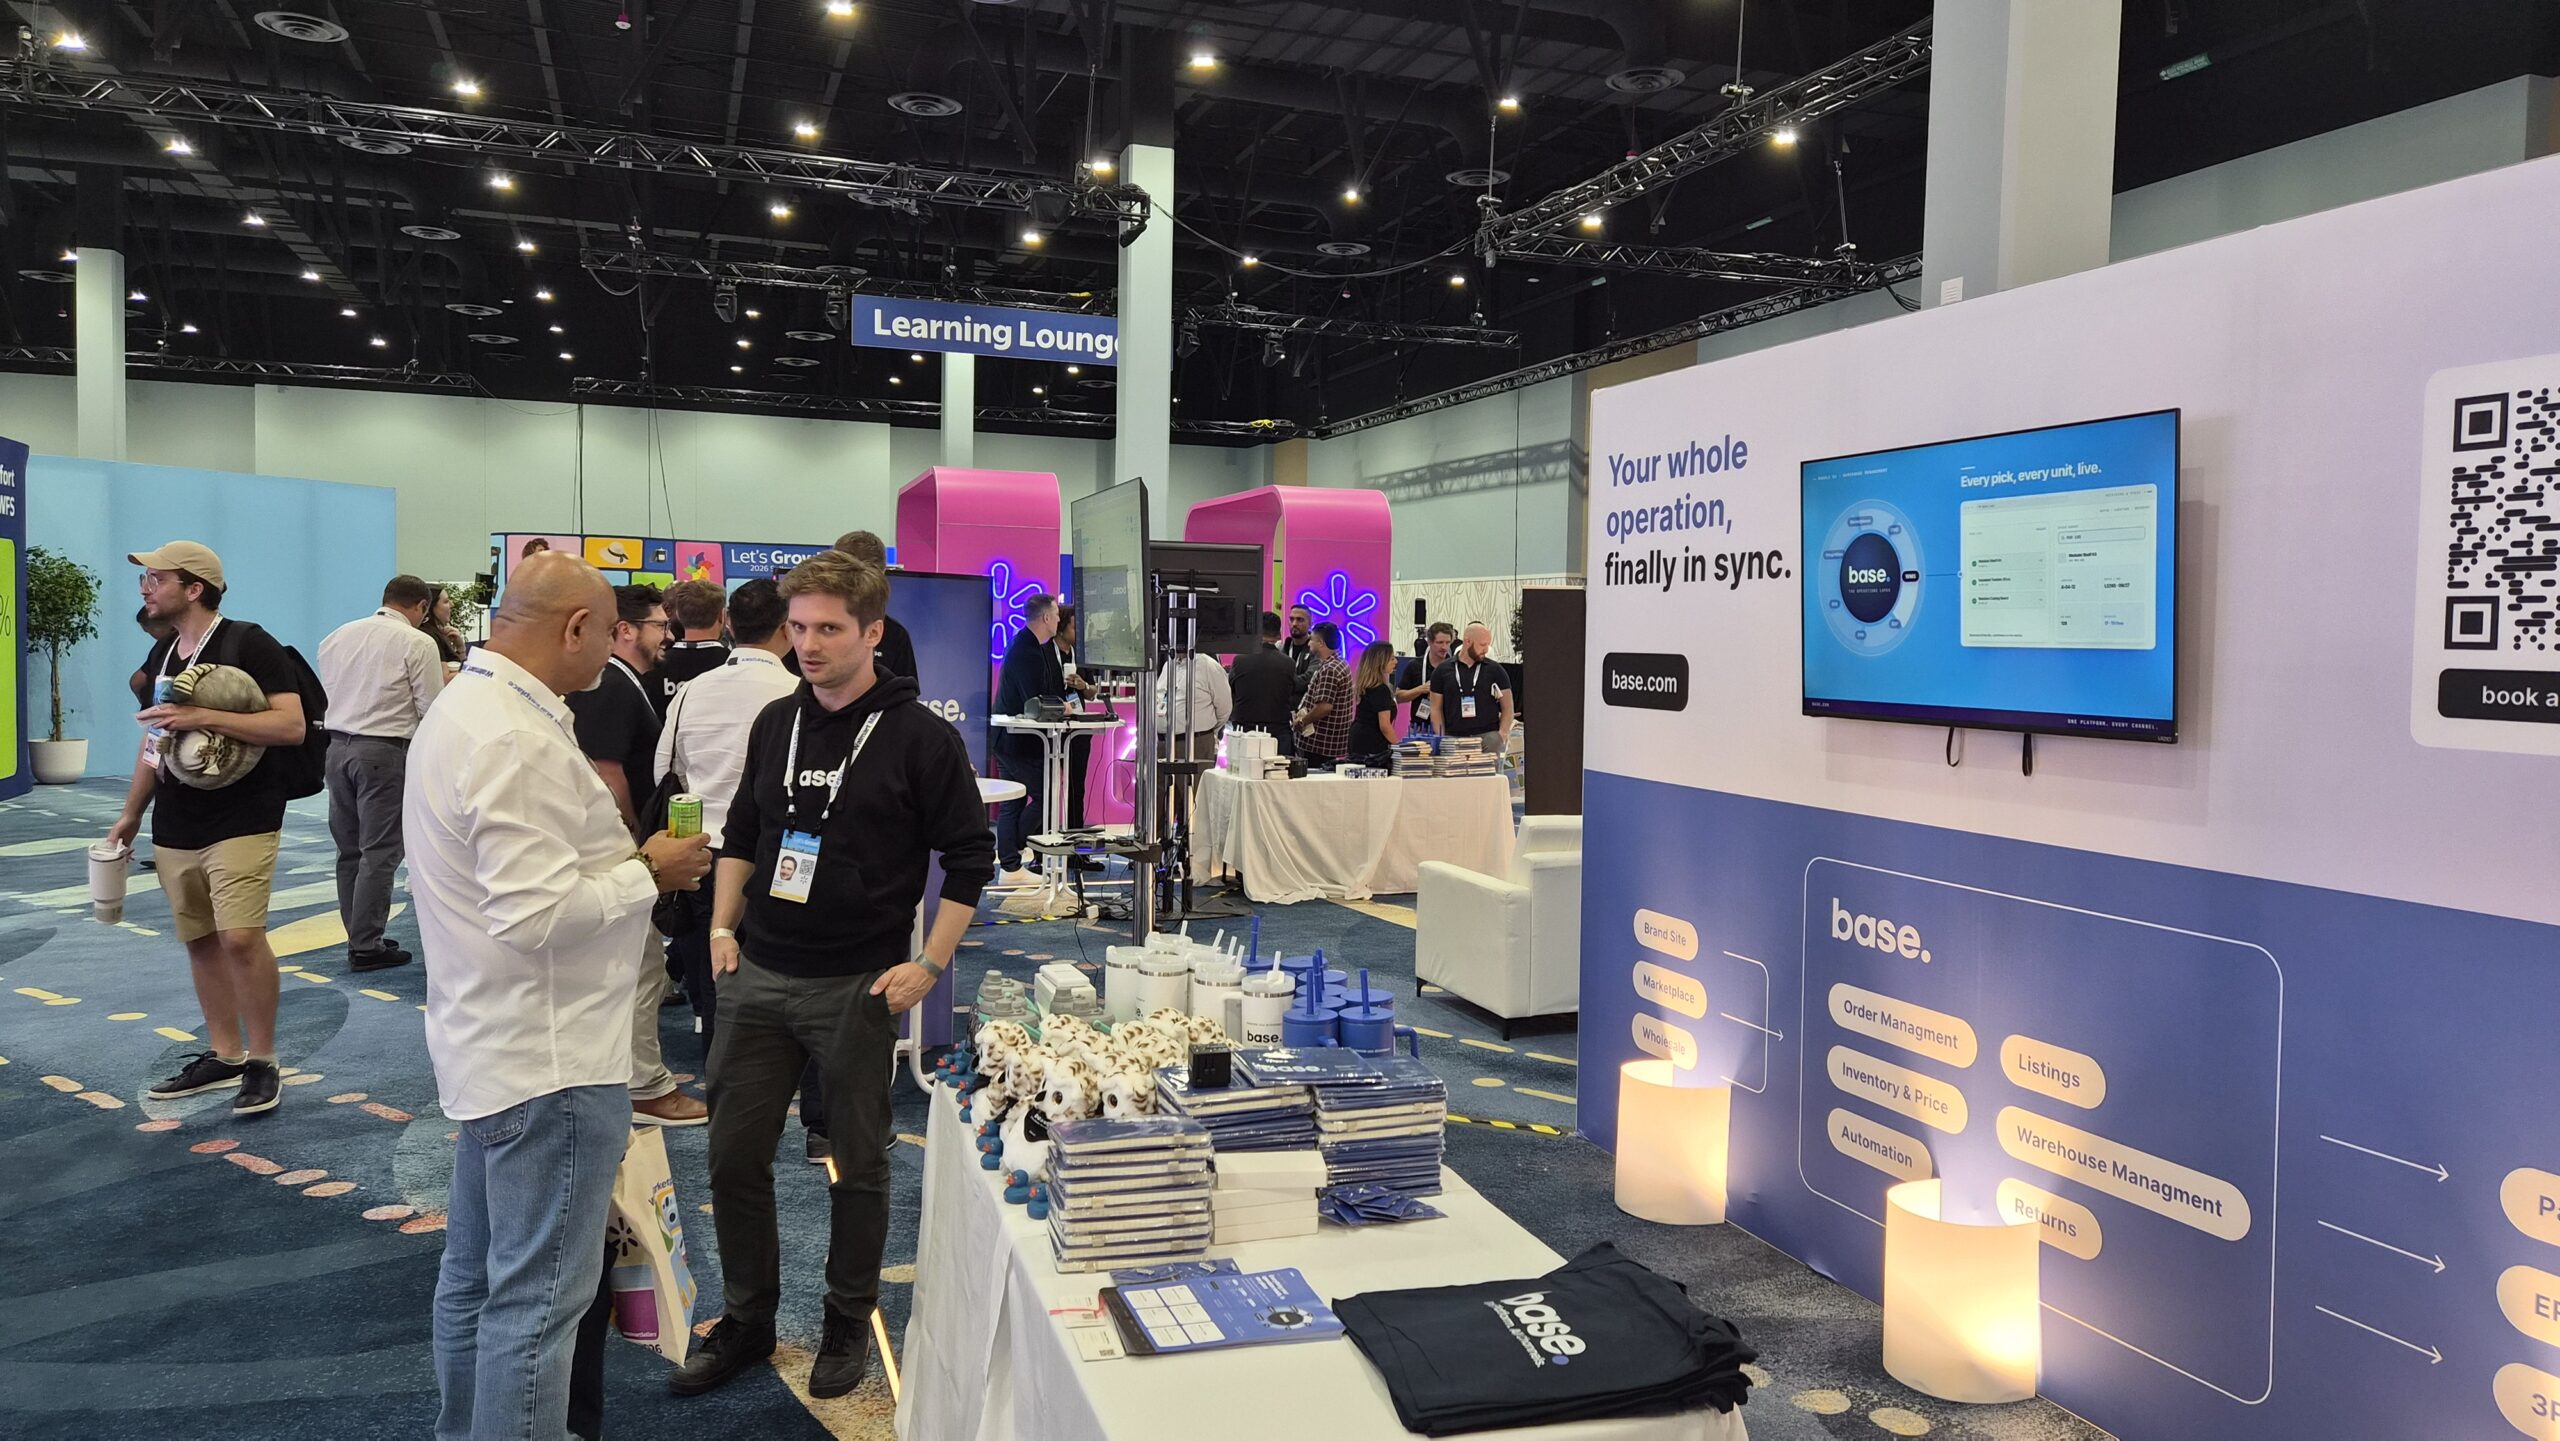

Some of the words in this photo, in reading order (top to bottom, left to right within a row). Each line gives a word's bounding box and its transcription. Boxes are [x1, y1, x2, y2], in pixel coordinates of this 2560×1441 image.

[874, 309, 1012, 350] Learning
[1019, 321, 1118, 359] Loung
[1608, 453, 1661, 487] Your
[1667, 434, 1748, 479] whole
[1960, 475, 1991, 489] Every
[1991, 471, 2017, 487] pick,
[2018, 468, 2050, 482] every
[2051, 463, 2076, 478] unit,
[2077, 461, 2102, 475] live.
[1606, 492, 1732, 544] operation,
[731, 549, 768, 564] Let's
[771, 550, 821, 565] Gro
[1605, 550, 1677, 592] finally
[1683, 545, 1706, 582] in
[1714, 549, 1791, 590] sync.
[1848, 565, 1891, 584] base.
[1611, 669, 1677, 693] base.com
[2482, 685, 2539, 707] book
[2545, 692, 2559, 707] a
[917, 699, 966, 722] se.
[2131, 723, 2159, 731] CHANNEL.
[799, 770, 839, 787] ase
[1644, 921, 1668, 940] Brand
[1670, 930, 1687, 946] Site
[1831, 897, 1931, 964] base.
[1643, 974, 1695, 1004] Marketplace
[1247, 1029, 1283, 1043] base.
[1843, 999, 1878, 1022] Order
[1880, 1011, 1958, 1050] Managment
[1642, 1025, 1686, 1056] Wholesale
[2018, 1053, 2081, 1089] Listings
[1842, 1062, 1900, 1099] Inventory
[1903, 1084, 1912, 1102] &
[1915, 1089, 1949, 1114] Price
[1841, 1125, 1913, 1168] Automation
[2016, 1125, 2108, 1173] Warehouse
[2112, 1160, 2223, 1218] Managment
[2014, 1197, 2077, 1237] Returns
